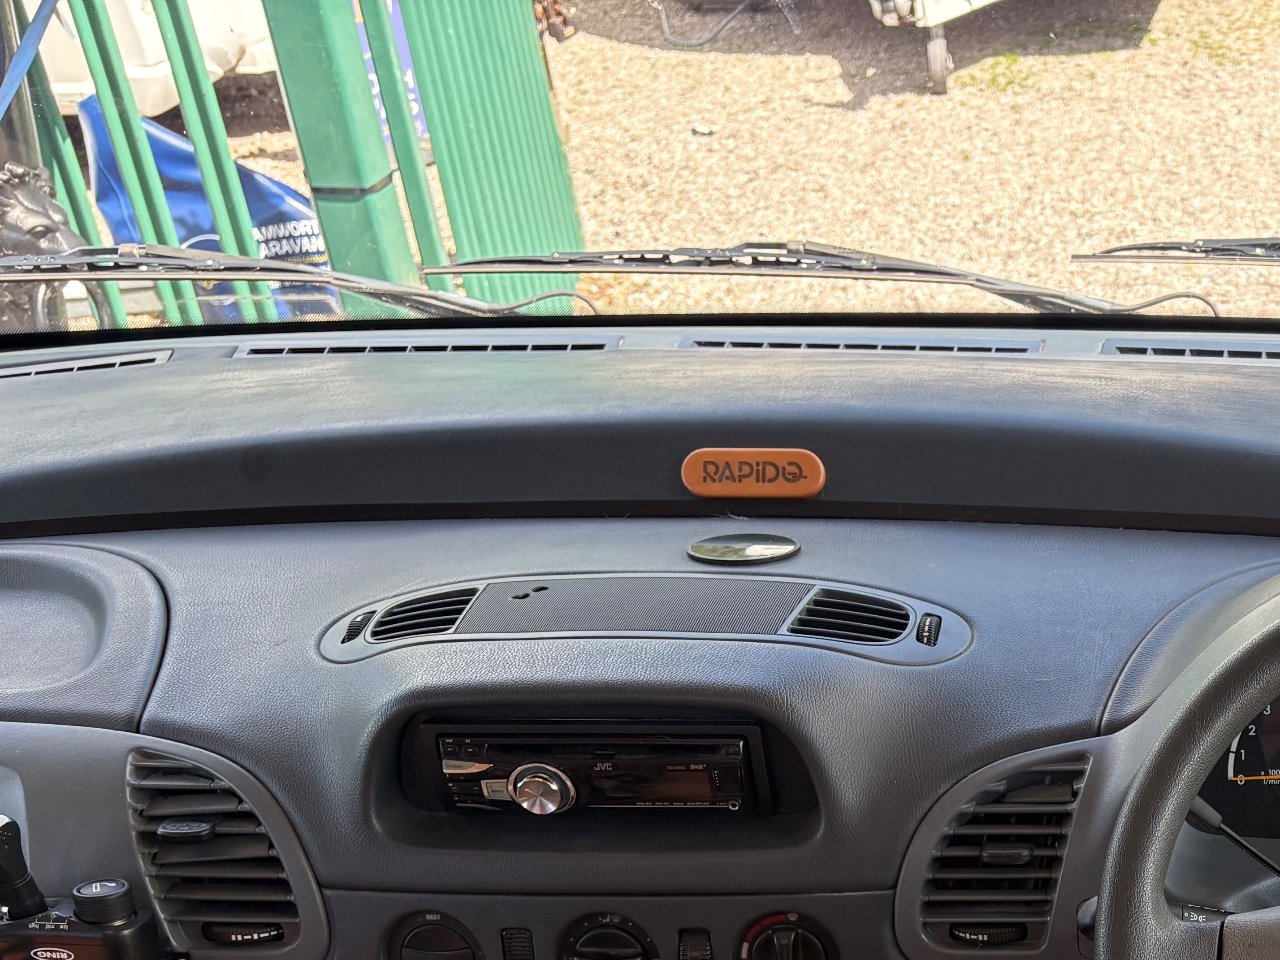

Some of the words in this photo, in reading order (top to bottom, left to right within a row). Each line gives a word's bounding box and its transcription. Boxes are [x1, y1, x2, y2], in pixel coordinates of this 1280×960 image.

[1263, 704, 1271, 715] 3
[1248, 725, 1256, 736] 2
[1240, 749, 1245, 760] 1
[594, 763, 613, 771] JVC
[36, 951, 68, 959] RING
